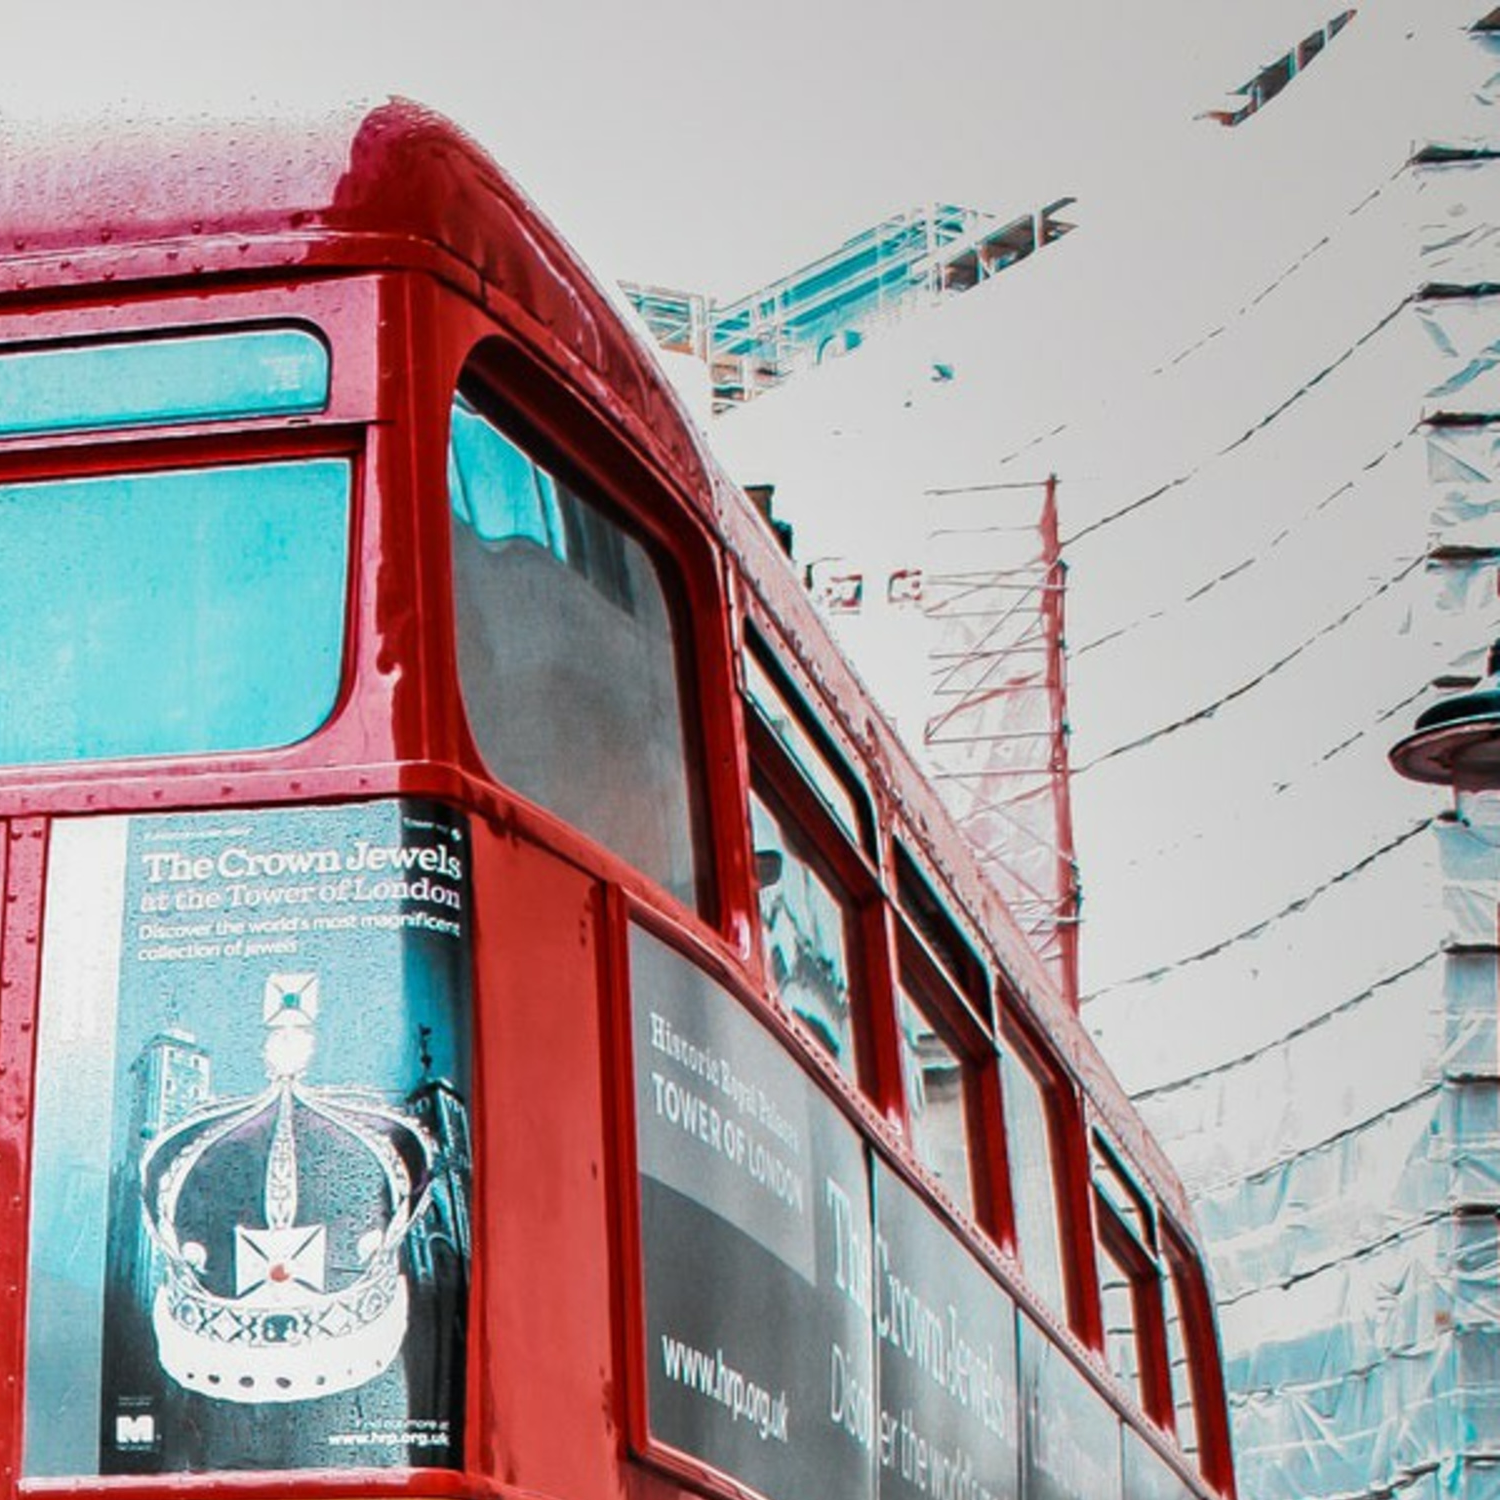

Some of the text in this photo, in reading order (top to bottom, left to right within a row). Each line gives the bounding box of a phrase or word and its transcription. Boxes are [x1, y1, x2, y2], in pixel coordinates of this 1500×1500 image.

[142, 841, 462, 884] The Crown Jewels
[141, 876, 461, 913] at the Tower of London
[139, 921, 211, 941] Discover
[215, 918, 244, 937] the
[313, 912, 357, 930] most
[138, 941, 220, 962] collection
[224, 940, 243, 957] of
[650, 1011, 719, 1087] Historic
[651, 1072, 722, 1152] TOWER
[723, 1119, 746, 1171] OF
[902, 1409, 927, 1491] the
